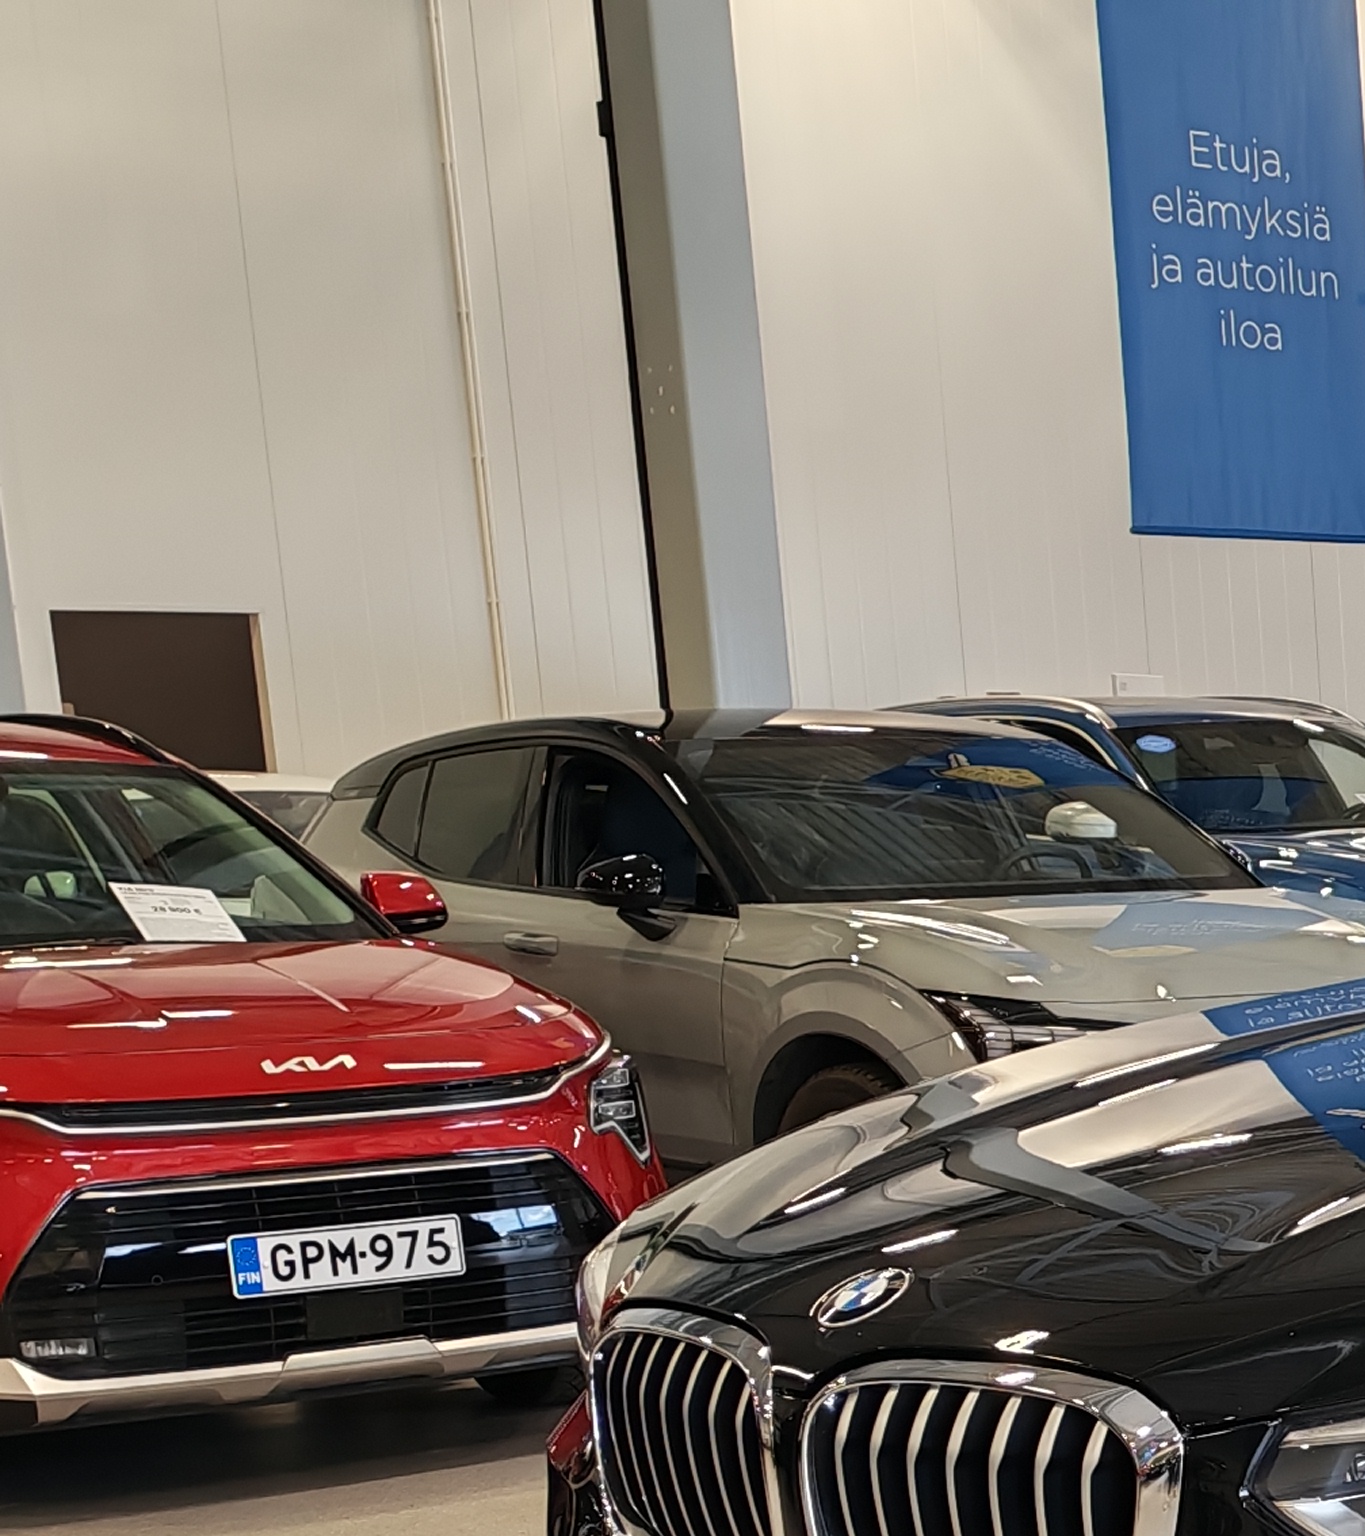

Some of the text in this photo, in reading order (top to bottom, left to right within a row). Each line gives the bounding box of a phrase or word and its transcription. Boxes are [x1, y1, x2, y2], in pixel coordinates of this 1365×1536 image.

[1187, 130, 1291, 184] Etuja,
[1152, 187, 1331, 243] elämyksiä
[1150, 244, 1339, 300] ja autoilun
[1218, 311, 1283, 351] iloa
[238, 1227, 451, 1285] FIN GPM-975
